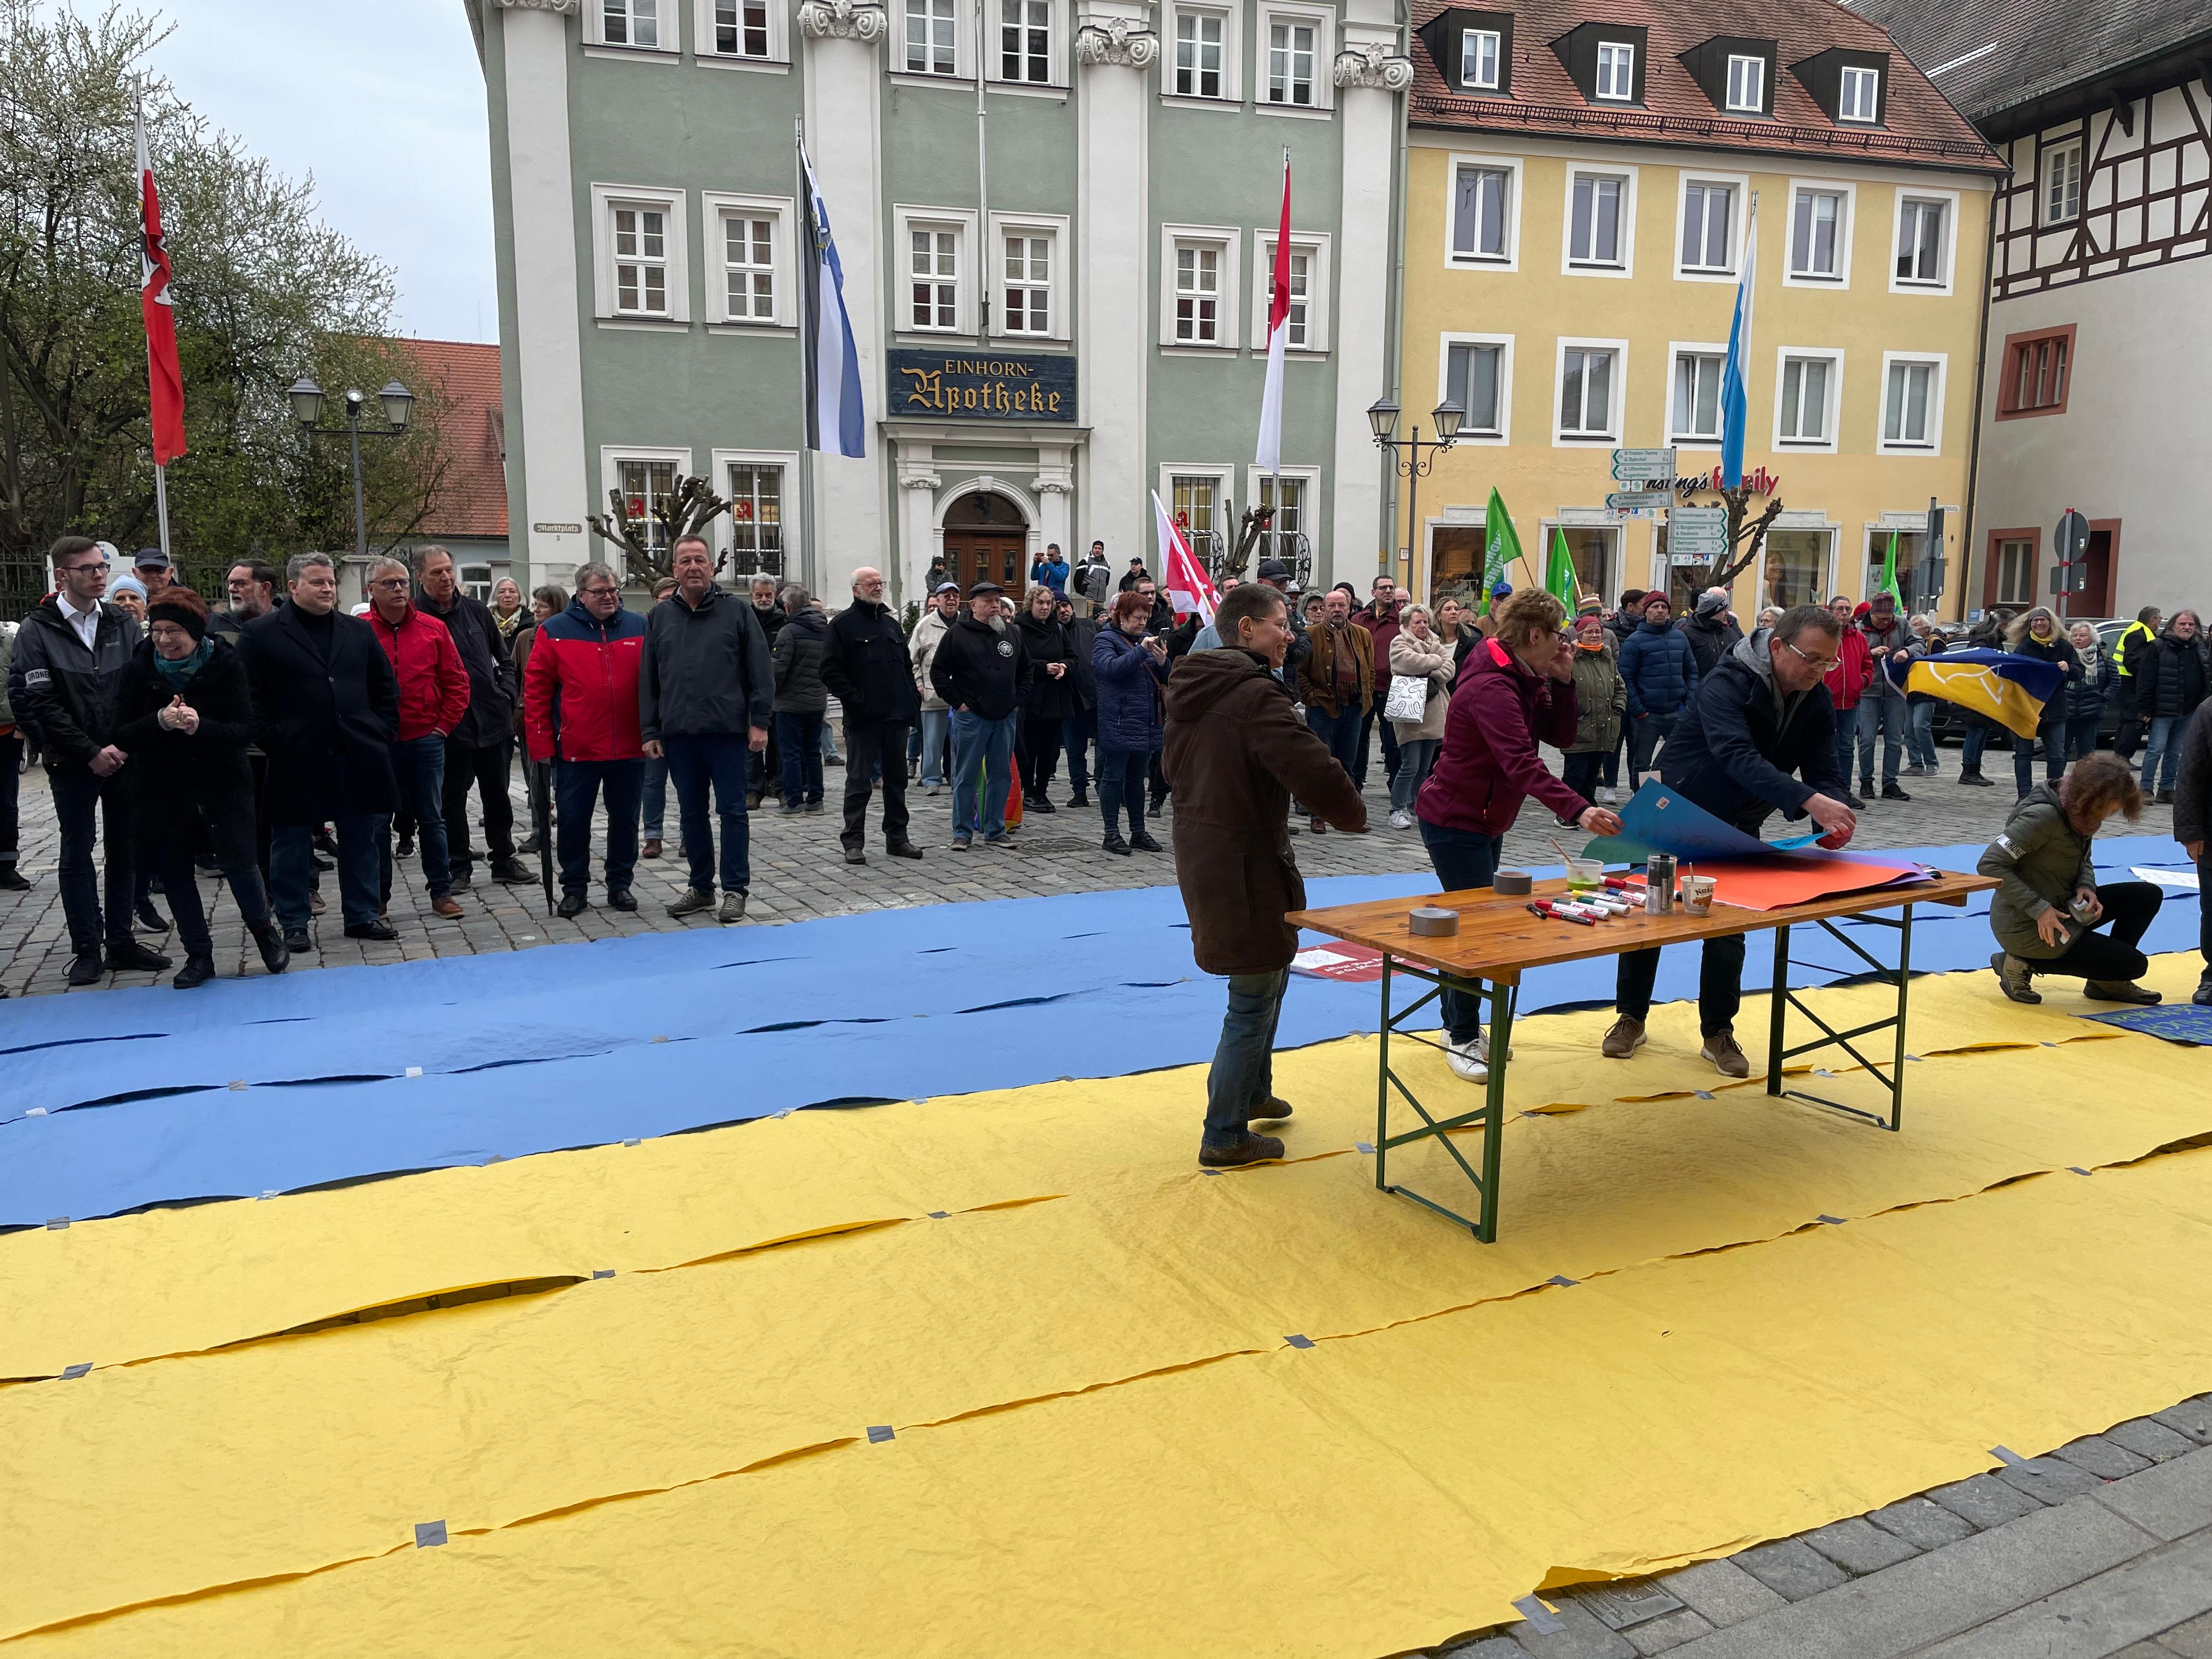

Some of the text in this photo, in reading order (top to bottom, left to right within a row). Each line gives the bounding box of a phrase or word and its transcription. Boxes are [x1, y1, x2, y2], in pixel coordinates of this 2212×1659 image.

[945, 359, 1034, 377] EINHORN-
[901, 367, 1061, 416] Apotheke
[537, 524, 579, 533] Marktplatz
